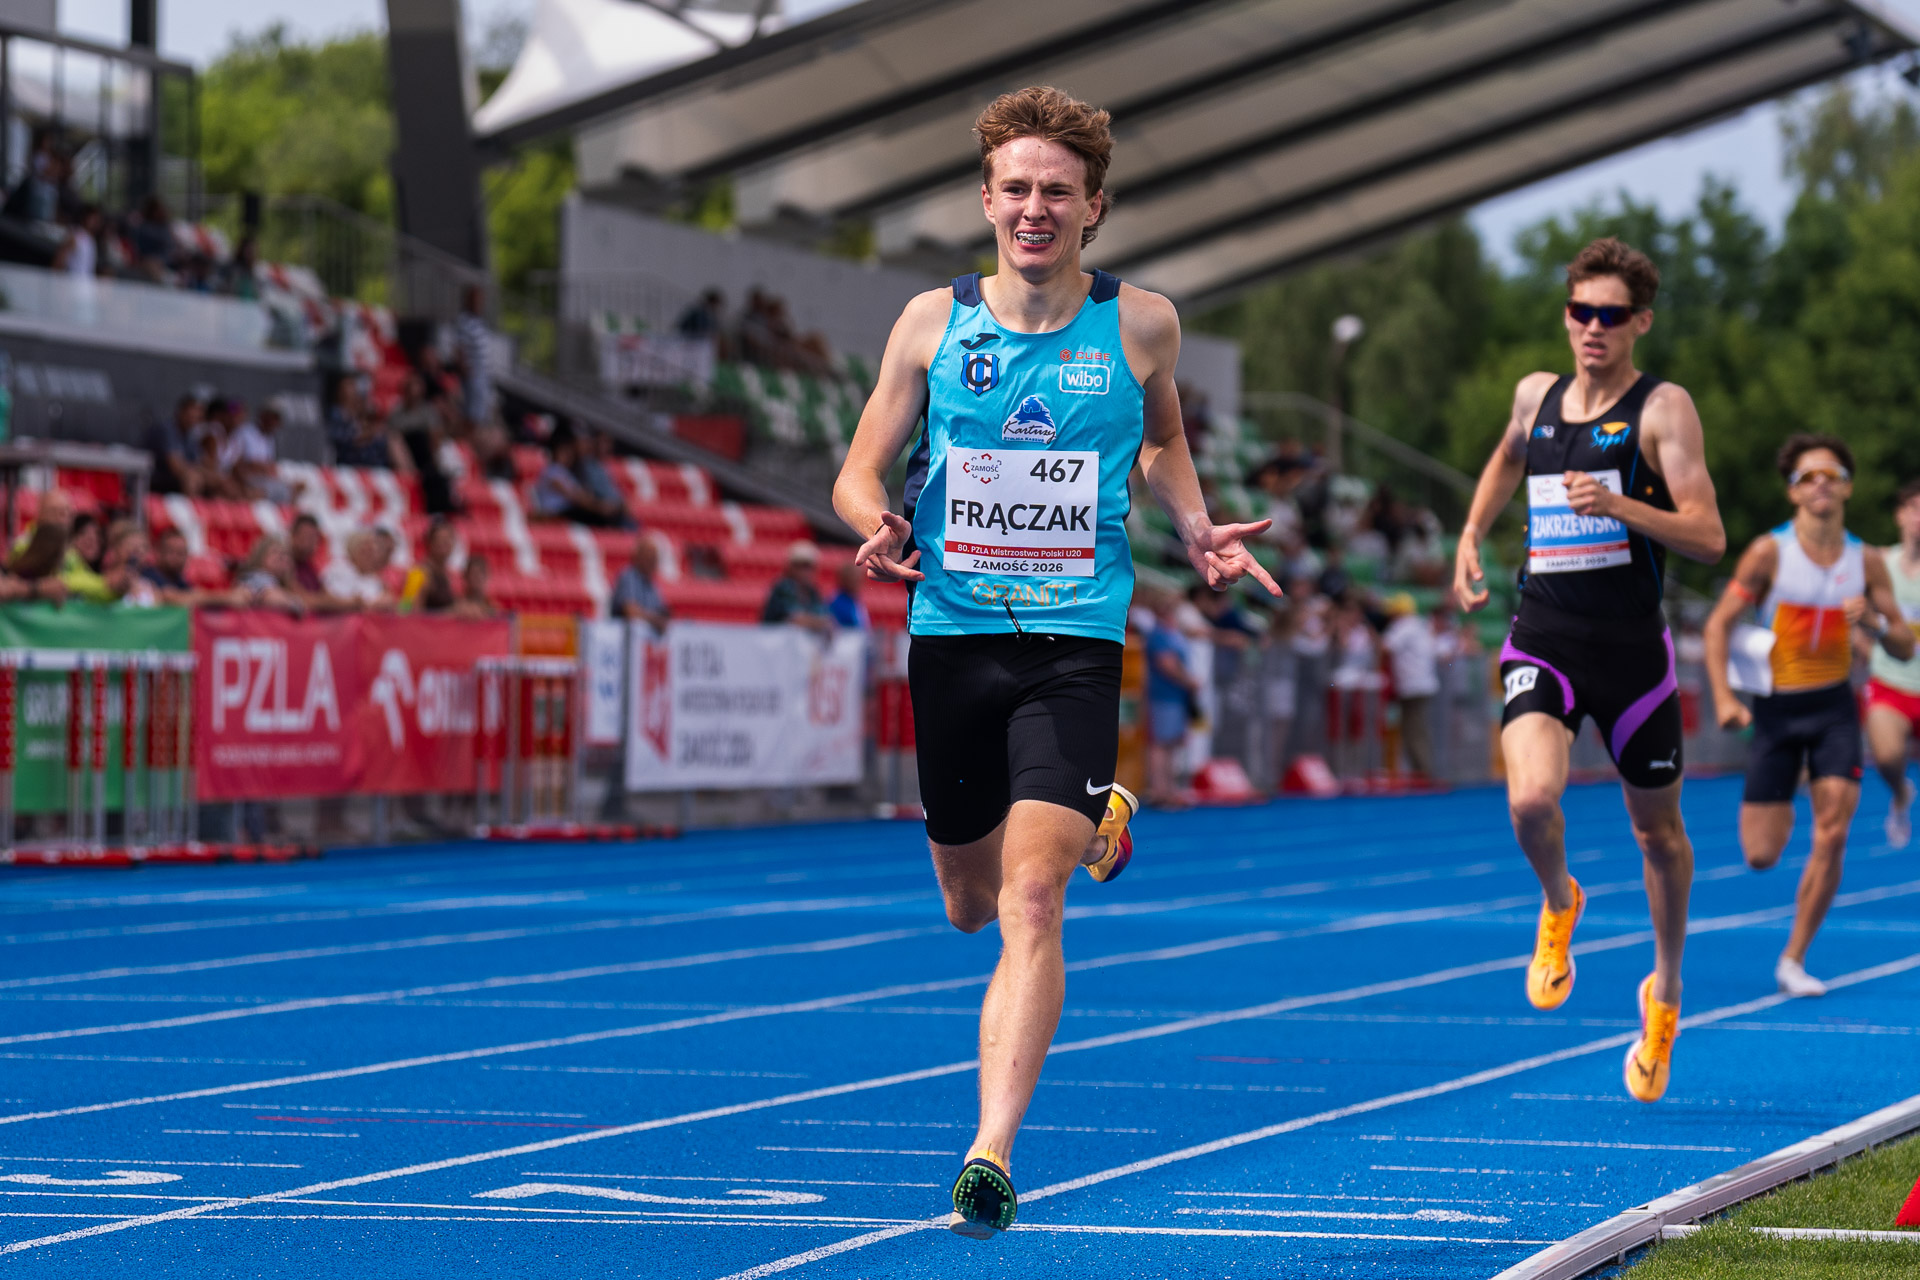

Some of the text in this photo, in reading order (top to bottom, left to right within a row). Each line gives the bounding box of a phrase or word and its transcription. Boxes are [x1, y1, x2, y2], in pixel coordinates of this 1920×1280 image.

[1076, 351, 1111, 361] CUBE
[1067, 371, 1103, 387] wibo
[1003, 420, 1056, 444] Kartuzy
[970, 464, 999, 473] ZAMOŚĆ
[1029, 458, 1085, 483] 467
[951, 498, 1091, 536] FRĄCZAK
[957, 543, 1082, 558] 80. PZLA Mistrzostwa Polski U20
[972, 558, 1064, 573] ZAMOŚĆ 2026
[211, 636, 341, 734] PZLA
[469, 1182, 827, 1207] 2
